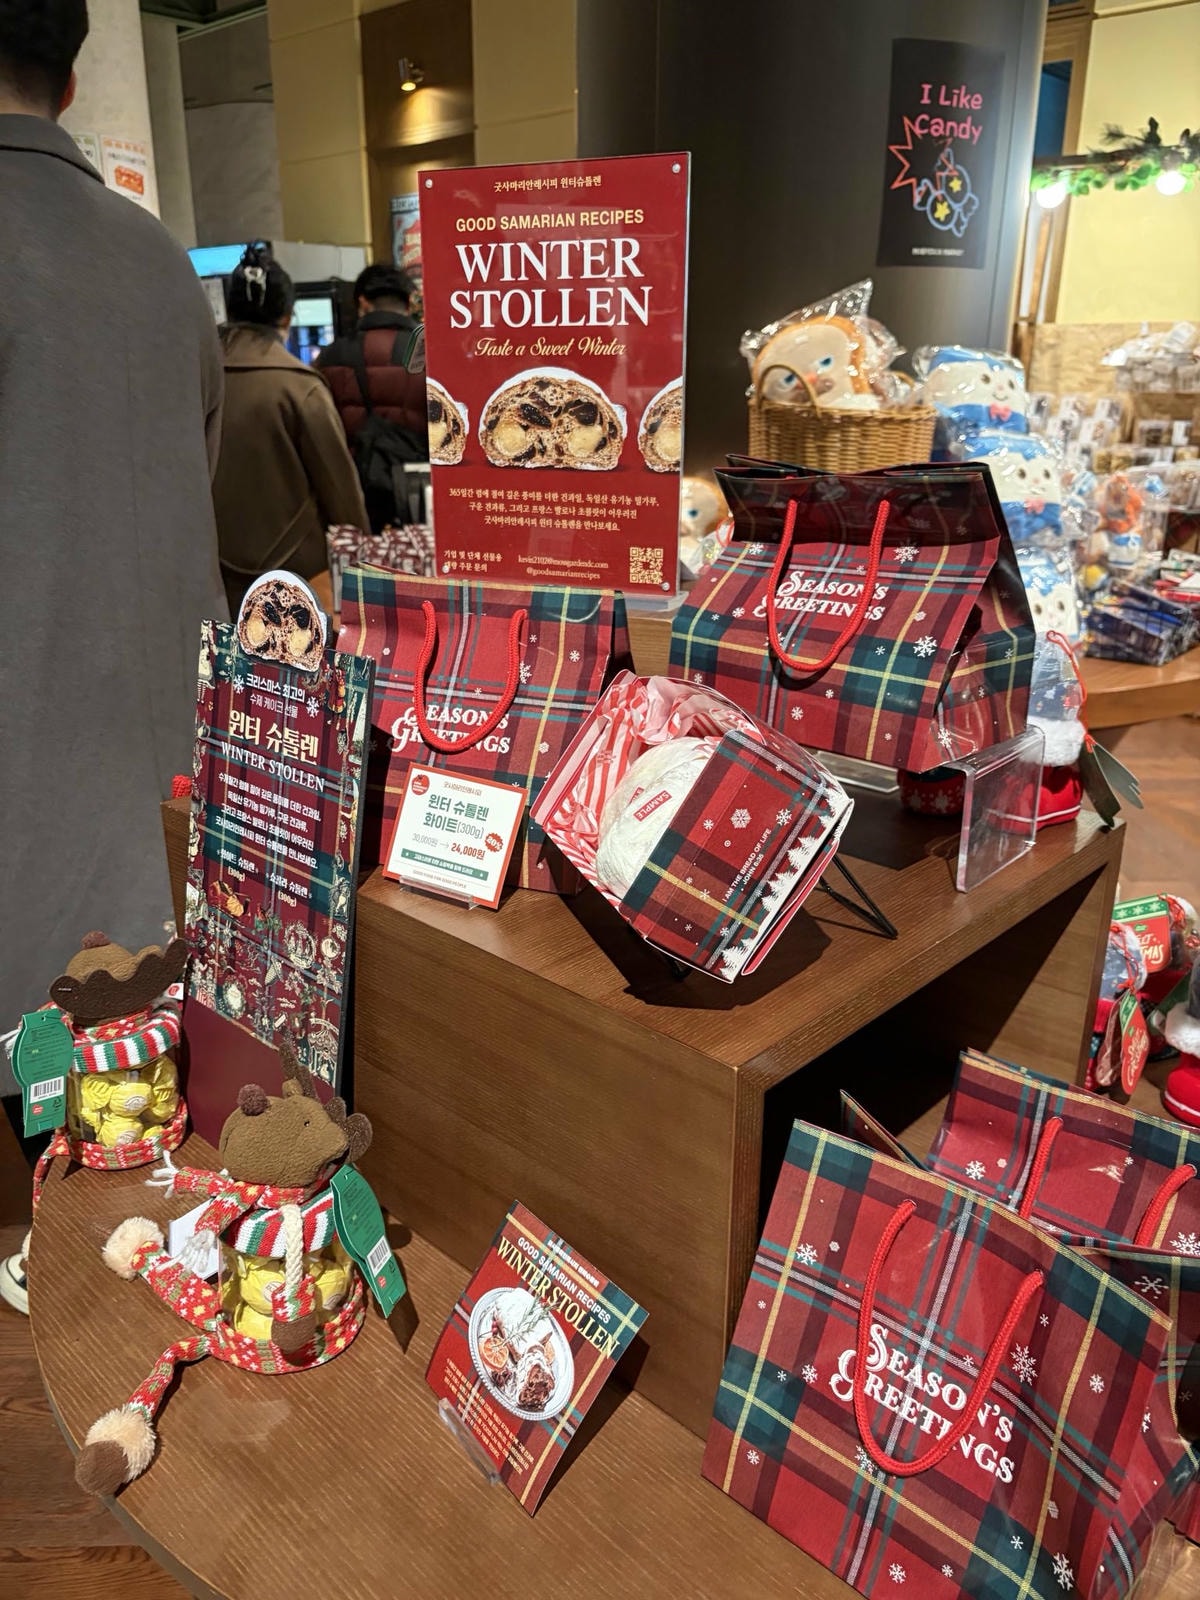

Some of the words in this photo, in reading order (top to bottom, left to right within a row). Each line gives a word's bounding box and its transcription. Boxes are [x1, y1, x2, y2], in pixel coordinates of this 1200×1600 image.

[920, 84, 932, 104] I
[938, 85, 983, 110] Like
[494, 178, 558, 192] 굿사마리안레시피
[455, 216, 496, 232] GOOD
[500, 213, 575, 230] SAMARIAN
[580, 209, 644, 227] RECIPES
[454, 237, 644, 283] WINTER
[450, 286, 653, 329] STOLLEN
[474, 336, 514, 358] Taste
[514, 345, 525, 357] a
[530, 337, 574, 357] Sweet
[578, 336, 627, 357] Winter
[246, 673, 282, 696] 크리스마스
[282, 684, 306, 703] 최고의
[229, 709, 261, 746] 윈터
[265, 722, 319, 766] 슈톨렌
[221, 741, 266, 771] WINTER
[268, 759, 325, 793] STOLLEN
[428, 793, 452, 812] 윈터
[453, 800, 490, 822] 슈톨렌
[635, 791, 669, 819] SAMPLE
[450, 842, 486, 861] 24,000원
[731, 873, 743, 888] THE
[740, 852, 757, 875] BREAD
[753, 842, 762, 853] OF
[760, 827, 772, 843] LIFE
[742, 866, 756, 885] JOHN
[517, 1236, 540, 1260] GOOD
[538, 1255, 578, 1294] SAMARIAN
[575, 1289, 612, 1325] RECIPES
[496, 1236, 552, 1299] WINTER
[547, 1285, 621, 1360] STOLLEN
